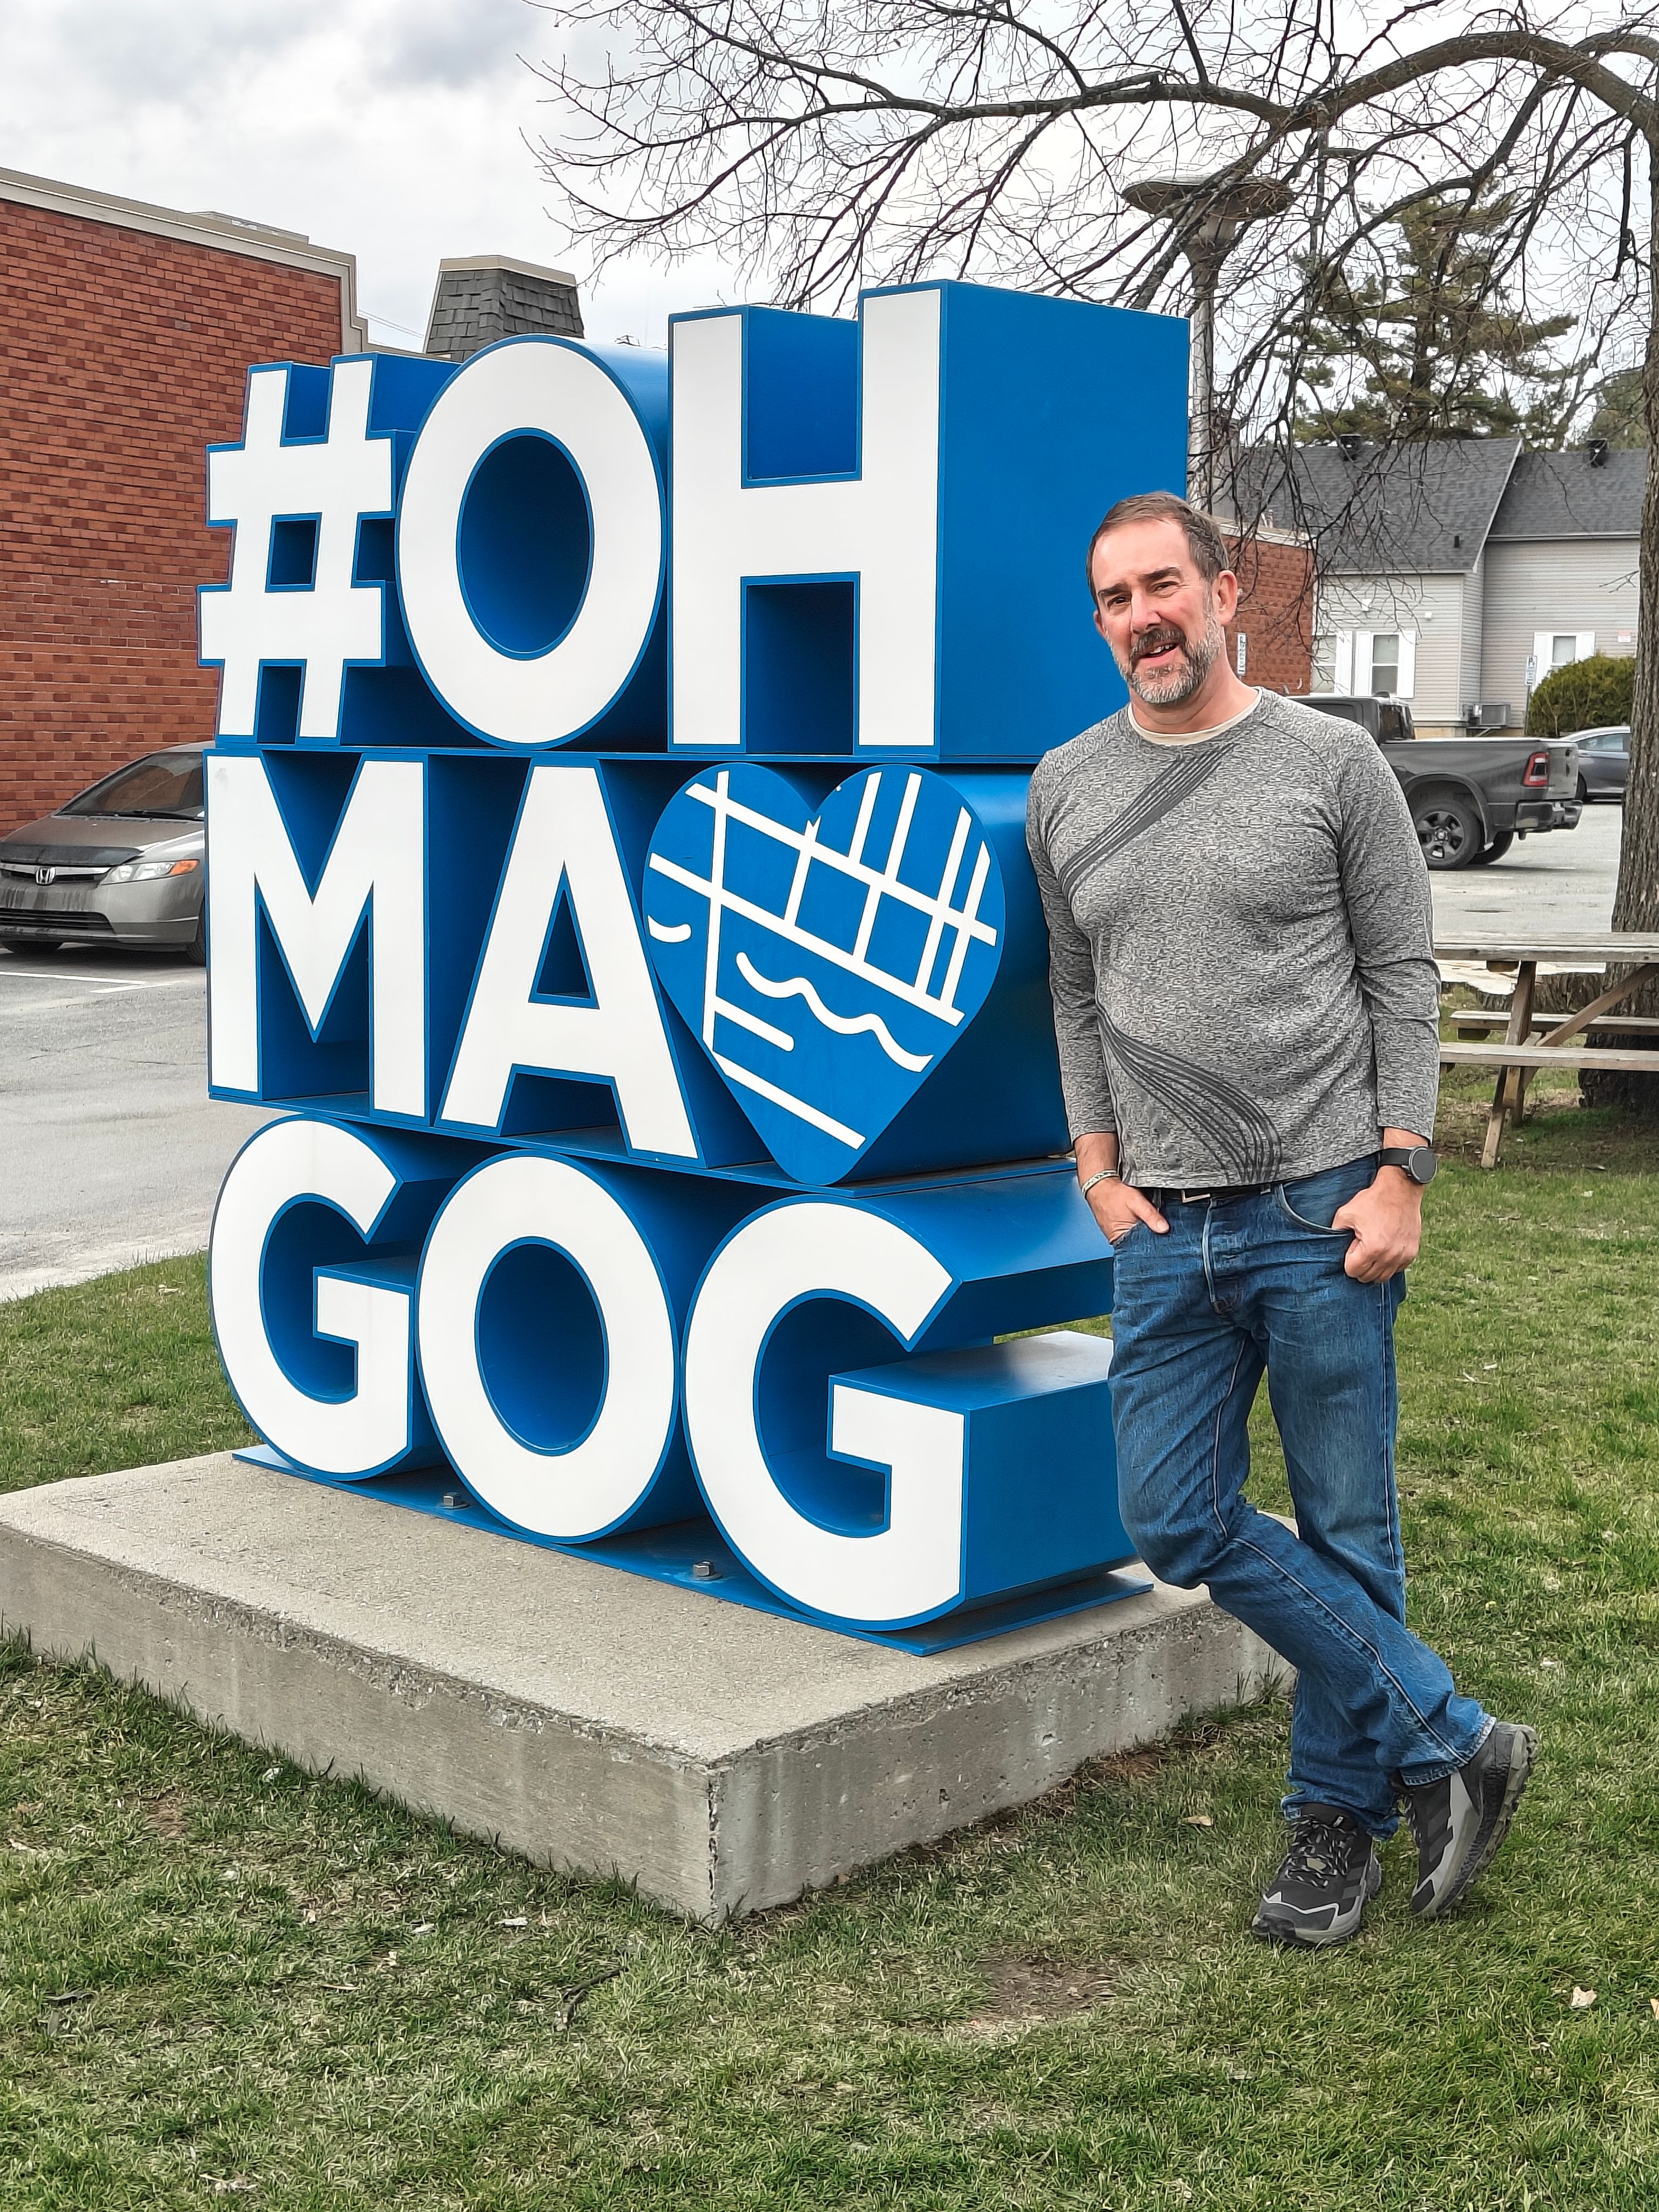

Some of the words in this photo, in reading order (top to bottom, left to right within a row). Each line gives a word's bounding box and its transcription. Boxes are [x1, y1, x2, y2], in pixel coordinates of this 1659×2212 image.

[199, 288, 942, 747] #OH
[207, 756, 698, 1159] MA
[211, 1120, 965, 1621] GOG
